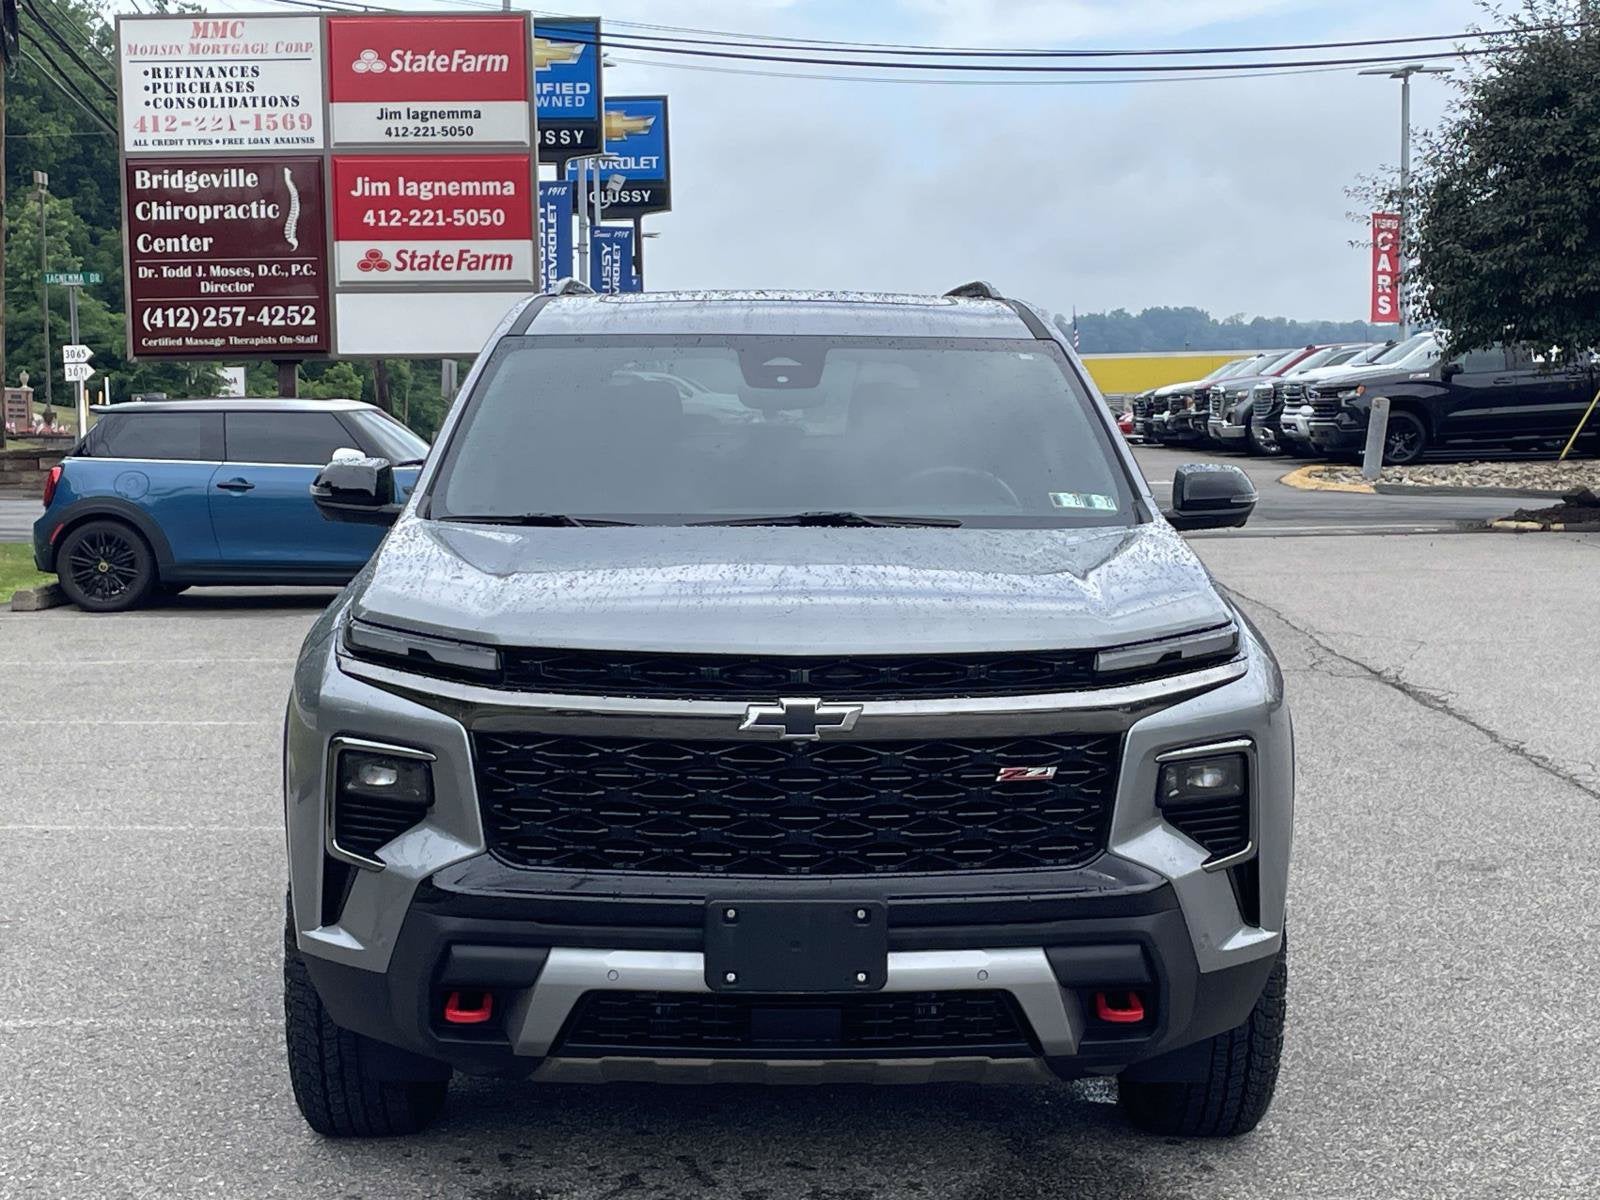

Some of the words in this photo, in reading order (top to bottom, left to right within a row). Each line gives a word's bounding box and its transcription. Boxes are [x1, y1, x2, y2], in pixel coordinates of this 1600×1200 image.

[190, 21, 246, 39] MMC
[188, 42, 268, 56] MORTGAGE
[151, 65, 260, 79] REFINANCES
[151, 81, 255, 94] PURCHASES
[152, 95, 300, 109] CONSOLIDATIONS
[376, 108, 402, 121] Jim
[133, 113, 313, 133] 412-221-1569
[384, 125, 474, 138] 412-221-5050
[132, 139, 149, 147] ALL
[151, 138, 184, 147] CREDIT
[186, 138, 213, 146] TYPES
[222, 137, 245, 145] FREE
[248, 137, 271, 145] LOAN
[273, 136, 315, 145] ANALYSIS
[135, 168, 259, 192] Bridgeville
[350, 176, 391, 197] Jim
[135, 199, 280, 224] Chiropractic
[362, 209, 506, 227] 412-221-5050
[136, 233, 213, 253] Center
[138, 265, 159, 278] Dr.
[161, 265, 192, 278] Todd
[195, 265, 207, 278] J.
[209, 265, 255, 279] Moses,
[1377, 231, 1394, 315] CARS
[200, 280, 255, 293] Director
[141, 337, 182, 346] Certified
[184, 337, 225, 348] Massage
[228, 335, 277, 346] Therapists
[279, 334, 318, 344] On-Staff
[65, 349, 87, 359] 3065
